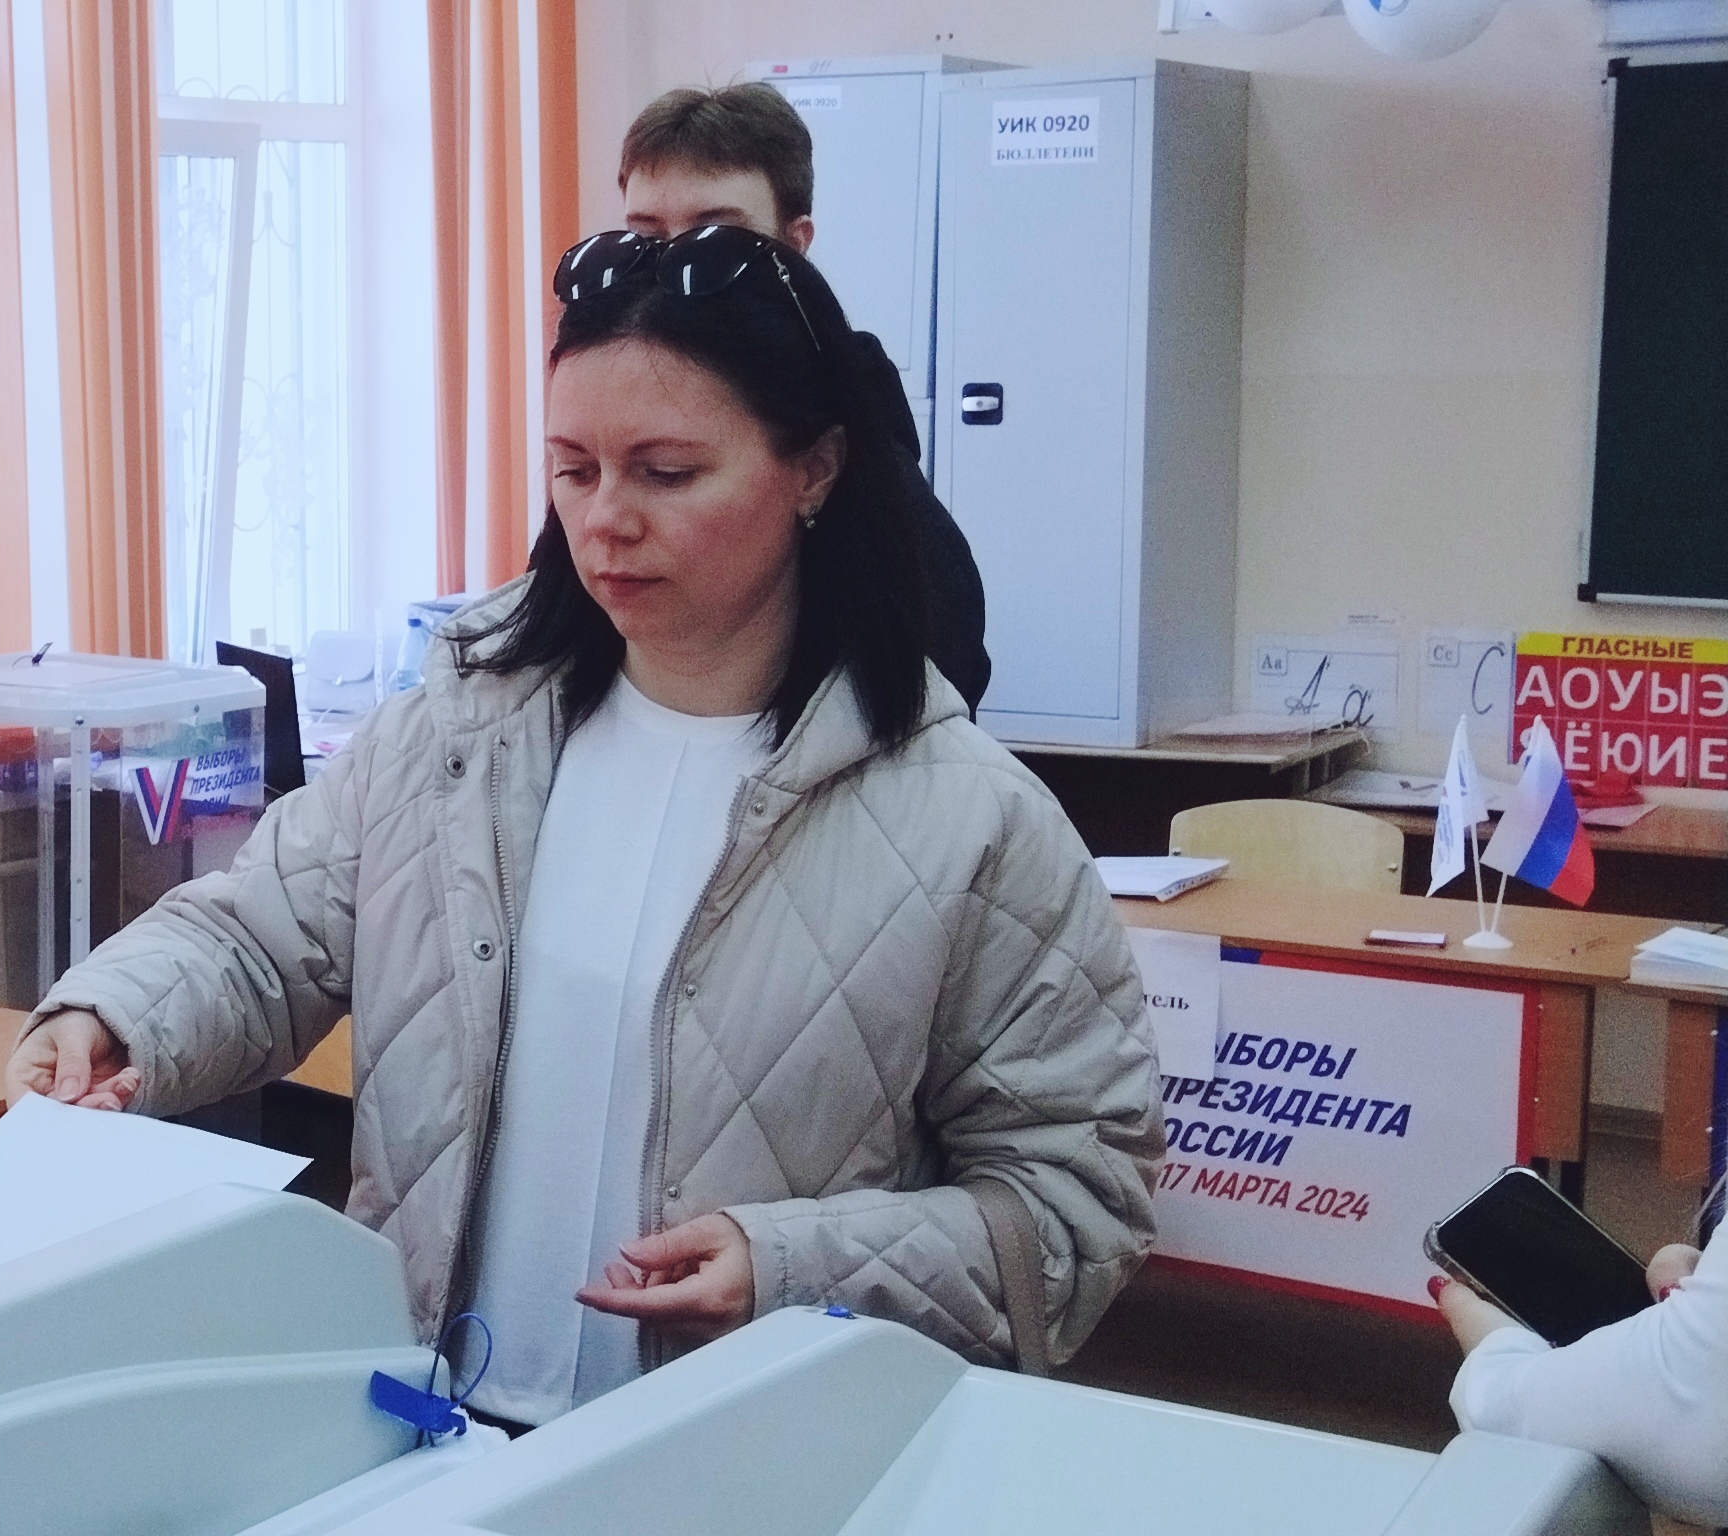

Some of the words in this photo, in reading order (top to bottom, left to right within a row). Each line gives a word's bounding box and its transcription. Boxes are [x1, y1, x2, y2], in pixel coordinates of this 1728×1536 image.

[997, 116, 1037, 134] УИК
[1042, 114, 1090, 133] 0920
[996, 145, 1095, 161] БЮЛЛЕТЕНИ
[1561, 636, 1695, 659] ГЛАСНЫЕ
[195, 746, 248, 772] ВЫБОРЫ
[189, 764, 262, 796] ПРЕЗИДЕНТА
[1142, 993, 1190, 1010] тель
[1190, 1166, 1292, 1209] МАРТА
[1295, 1184, 1371, 1222] 2024
